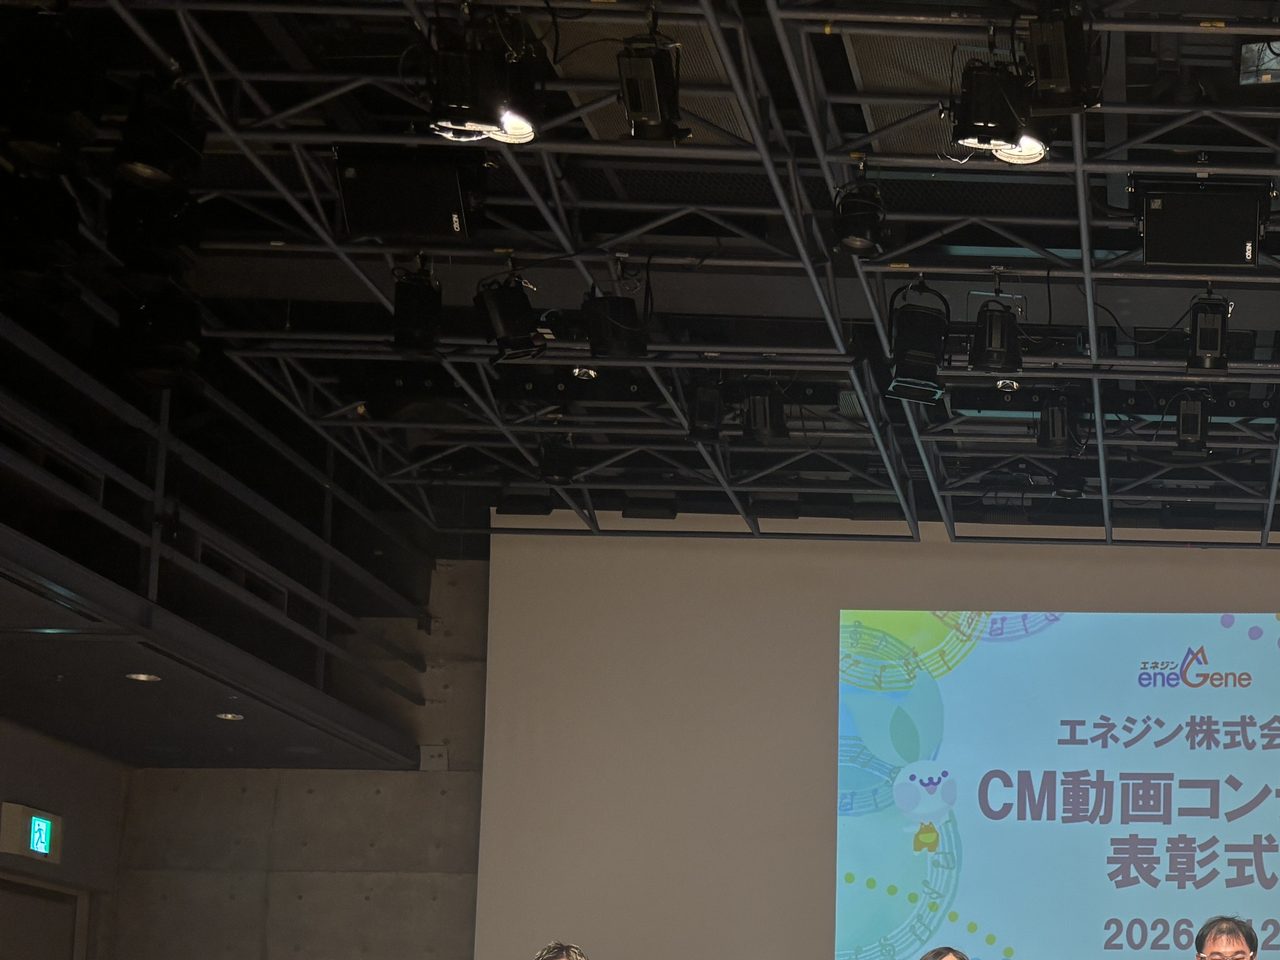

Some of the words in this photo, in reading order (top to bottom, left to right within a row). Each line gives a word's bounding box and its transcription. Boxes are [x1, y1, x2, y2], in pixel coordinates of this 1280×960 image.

[1140, 661, 1179, 671] エネジン
[1106, 834, 1280, 890] 表彰式
[1103, 918, 1194, 950] 2026
